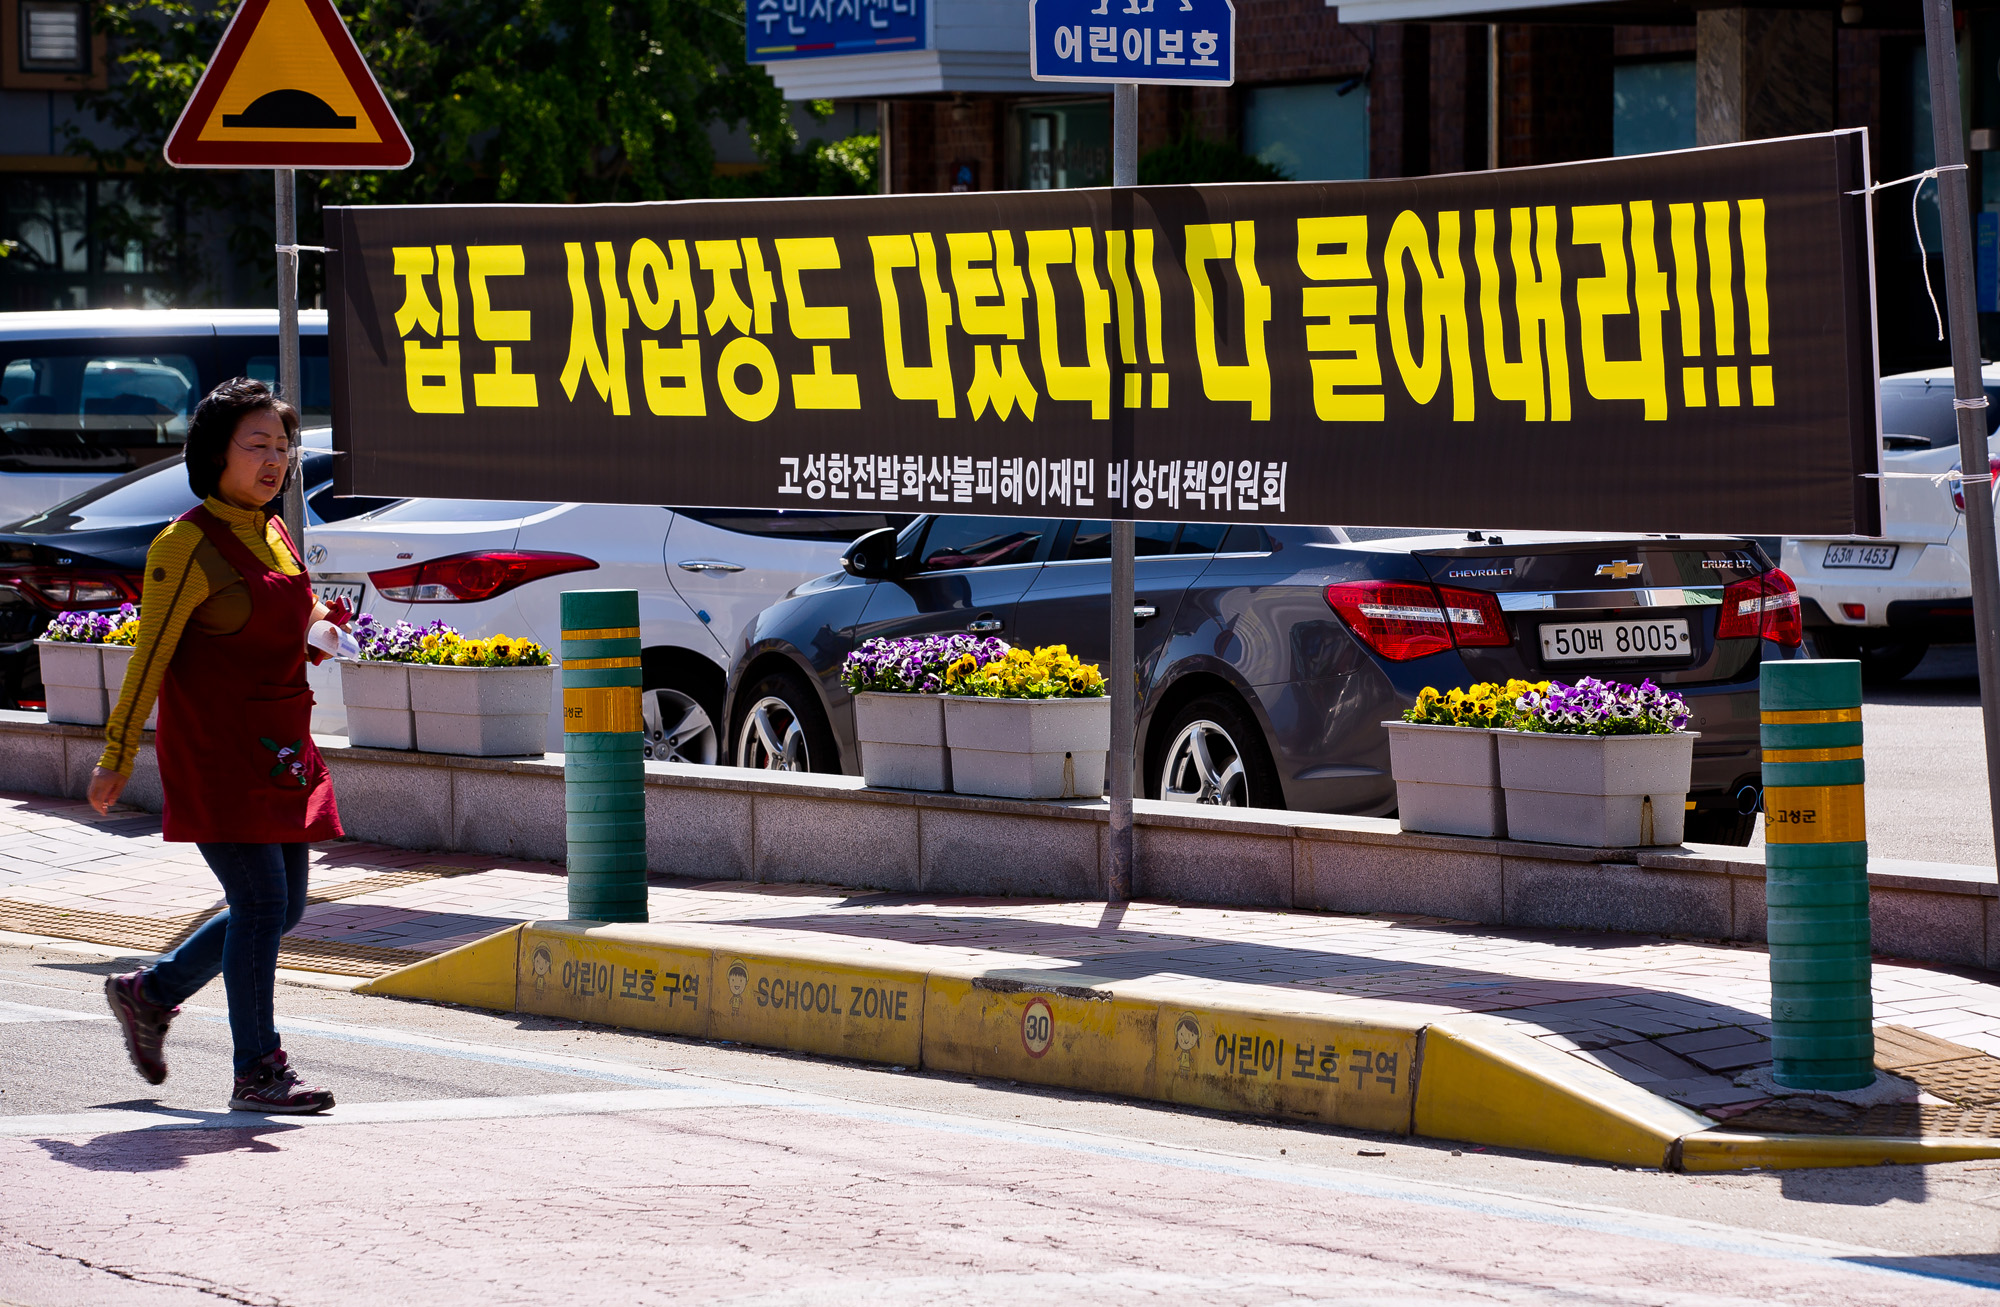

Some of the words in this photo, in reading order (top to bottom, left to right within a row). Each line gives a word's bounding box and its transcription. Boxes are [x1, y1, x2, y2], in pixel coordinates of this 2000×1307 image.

[1054, 25, 1219, 67] 어린이보호
[392, 244, 539, 414] 집도
[559, 237, 861, 422] 사업장도
[1185, 220, 1271, 421] 다
[1297, 199, 1775, 422] 물어내라!!!
[778, 452, 1095, 507] 고성한전발화산불피해이재민
[1107, 459, 1288, 512] 비상대책위원회
[1449, 567, 1514, 578] CHEVROLET
[1702, 560, 1734, 569] CRUZE
[1736, 559, 1751, 569] LTZ
[1858, 547, 1889, 564] 1453
[1555, 627, 1603, 655] 50버
[1616, 625, 1678, 652] 8005
[1777, 809, 1817, 825] 고성군
[562, 958, 614, 1000] 어린이
[620, 966, 656, 1003] 보호
[663, 971, 700, 1011] 구역
[757, 976, 842, 1015] SCHOOL
[850, 986, 908, 1021] ZONE
[1026, 1014, 1048, 1042] 30
[1214, 1032, 1284, 1081] 어린이
[1291, 1045, 1340, 1084] 보호
[1349, 1049, 1398, 1094] 구역
